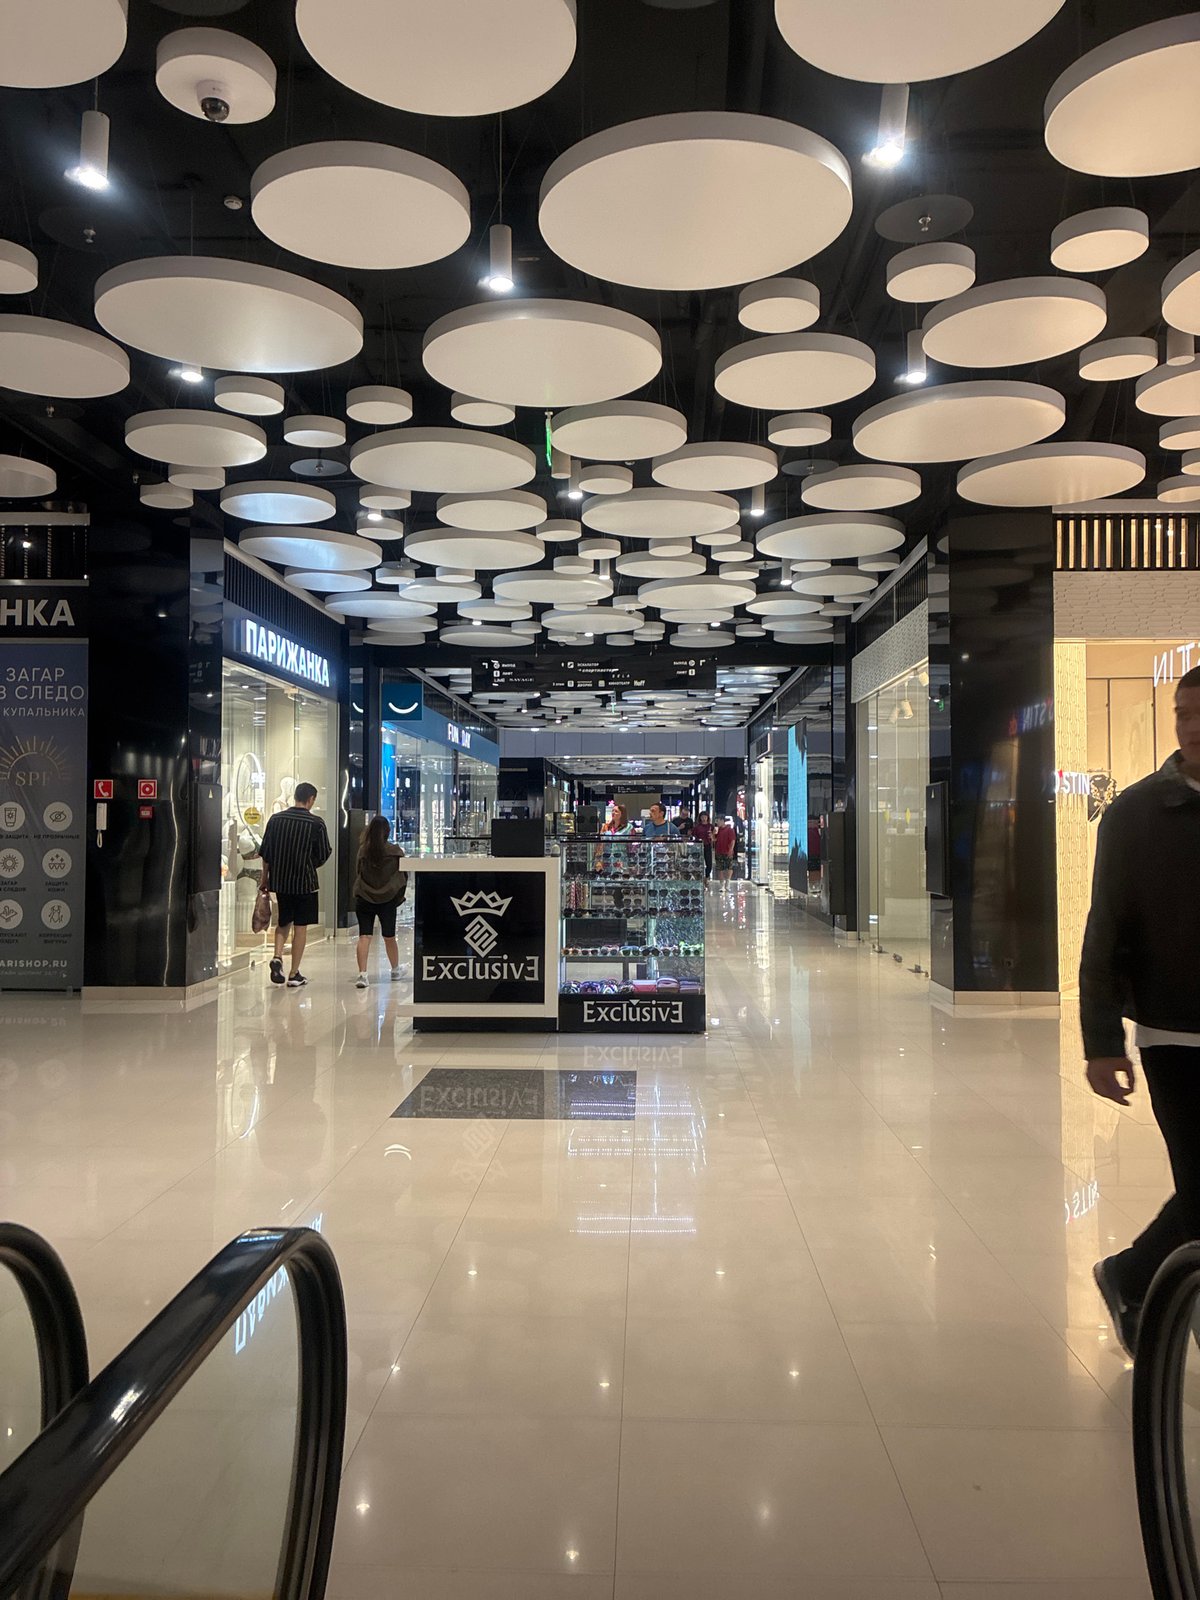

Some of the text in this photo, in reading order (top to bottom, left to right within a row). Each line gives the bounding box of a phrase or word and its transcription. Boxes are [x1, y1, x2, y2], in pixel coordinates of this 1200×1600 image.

[0, 599, 75, 626] НКА
[244, 619, 329, 687] ПАРИЖАНКА
[6, 667, 65, 682] ЗАГАР
[15, 685, 85, 701] СЛЕДО
[3, 707, 85, 717] КУПАЛЬНИКА
